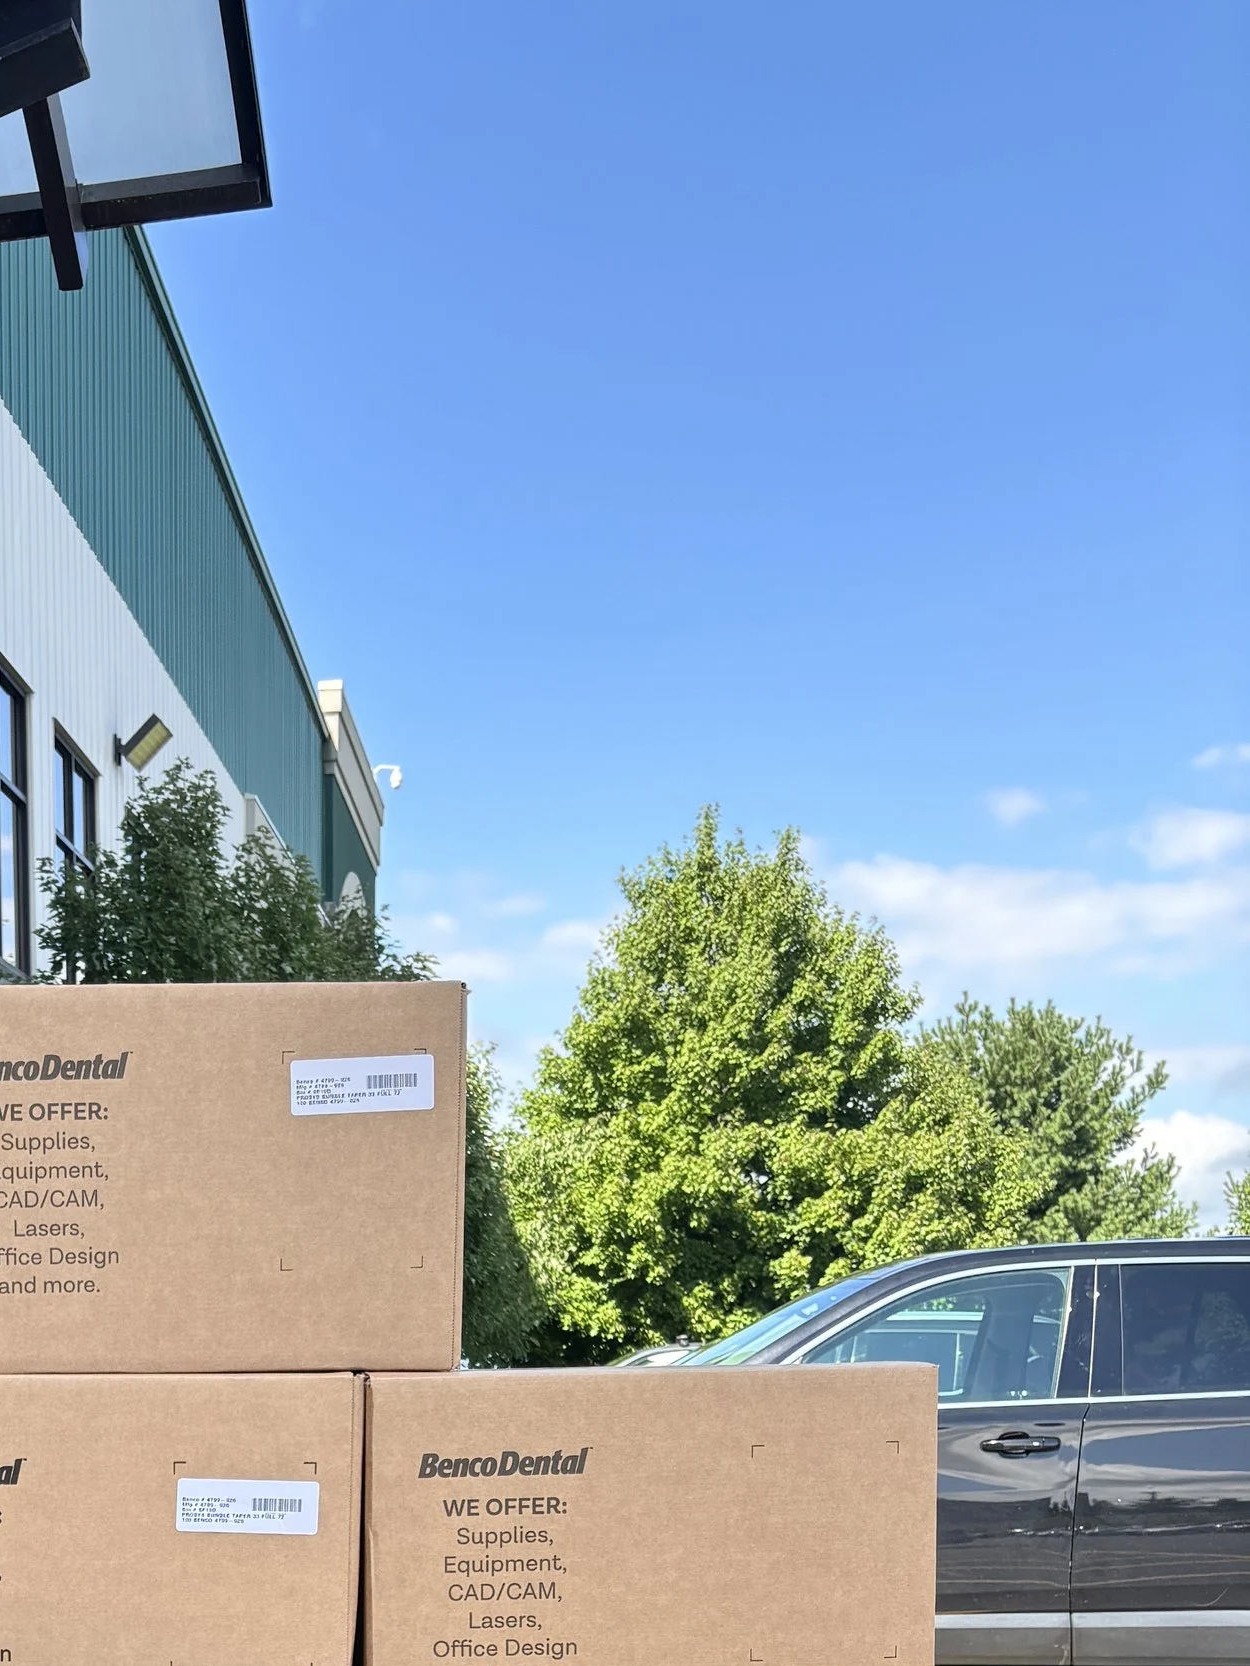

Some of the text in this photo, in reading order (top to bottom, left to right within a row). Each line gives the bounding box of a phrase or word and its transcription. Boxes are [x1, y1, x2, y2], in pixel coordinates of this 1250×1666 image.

[29, 1102, 108, 1121] OFFER:
[2, 1132, 95, 1156] Supplies,
[14, 1220, 84, 1239] Lasers,
[50, 1247, 118, 1268] Design
[0, 1276, 100, 1294] and more.
[418, 1447, 588, 1478] BencoDental
[443, 1497, 567, 1517] WE OFFER:
[457, 1526, 553, 1550] Supplies,
[445, 1555, 566, 1578] Equipment,
[449, 1582, 562, 1602] CAD/CAM,
[470, 1612, 541, 1630] Lasers,
[433, 1638, 577, 1660] Office Design
